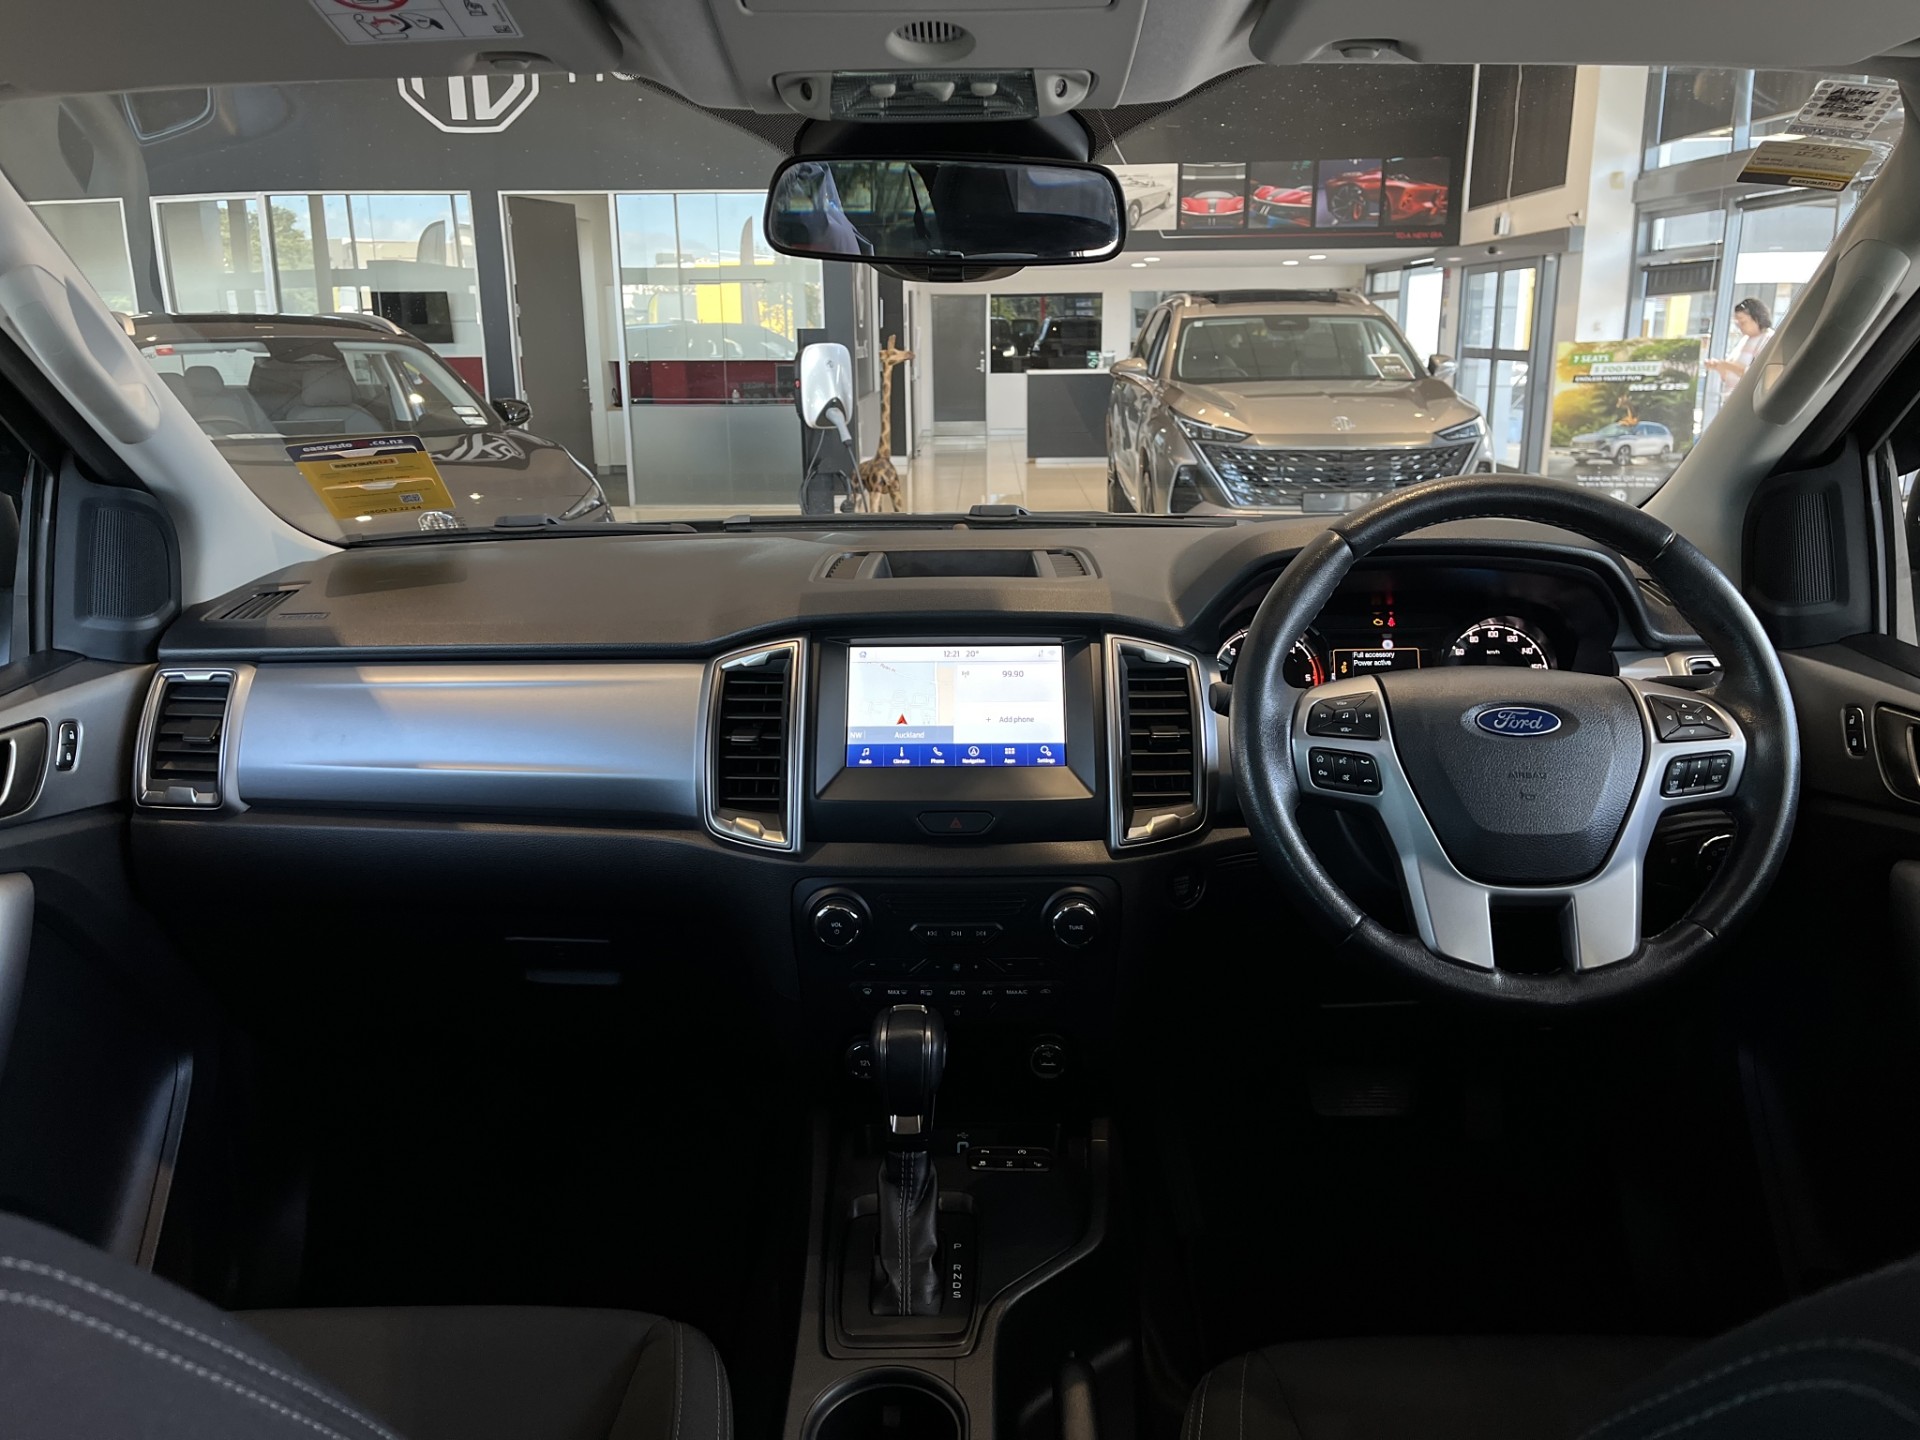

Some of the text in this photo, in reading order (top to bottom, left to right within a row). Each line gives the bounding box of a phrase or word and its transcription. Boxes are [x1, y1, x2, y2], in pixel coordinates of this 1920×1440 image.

[1581, 354, 1609, 363] SEATS
[334, 458, 394, 469] easyauto123
[1487, 630, 1499, 638] 100
[1506, 635, 1518, 643] 120
[943, 650, 960, 658] 12:21
[1230, 648, 1237, 656] 2
[1455, 648, 1465, 656] 60
[1521, 647, 1533, 655] 140
[1002, 670, 1024, 678] 99.90
[1305, 673, 1312, 681] 5
[1013, 716, 1035, 724] phone
[1493, 710, 1543, 729] Ford
[894, 731, 925, 739] Auckland
[1508, 771, 1548, 779] AIRBAG
[953, 1242, 962, 1250] P
[953, 1263, 962, 1271] R
[953, 1272, 963, 1281] N
[952, 1281, 962, 1289] D
[952, 1291, 962, 1299] S
